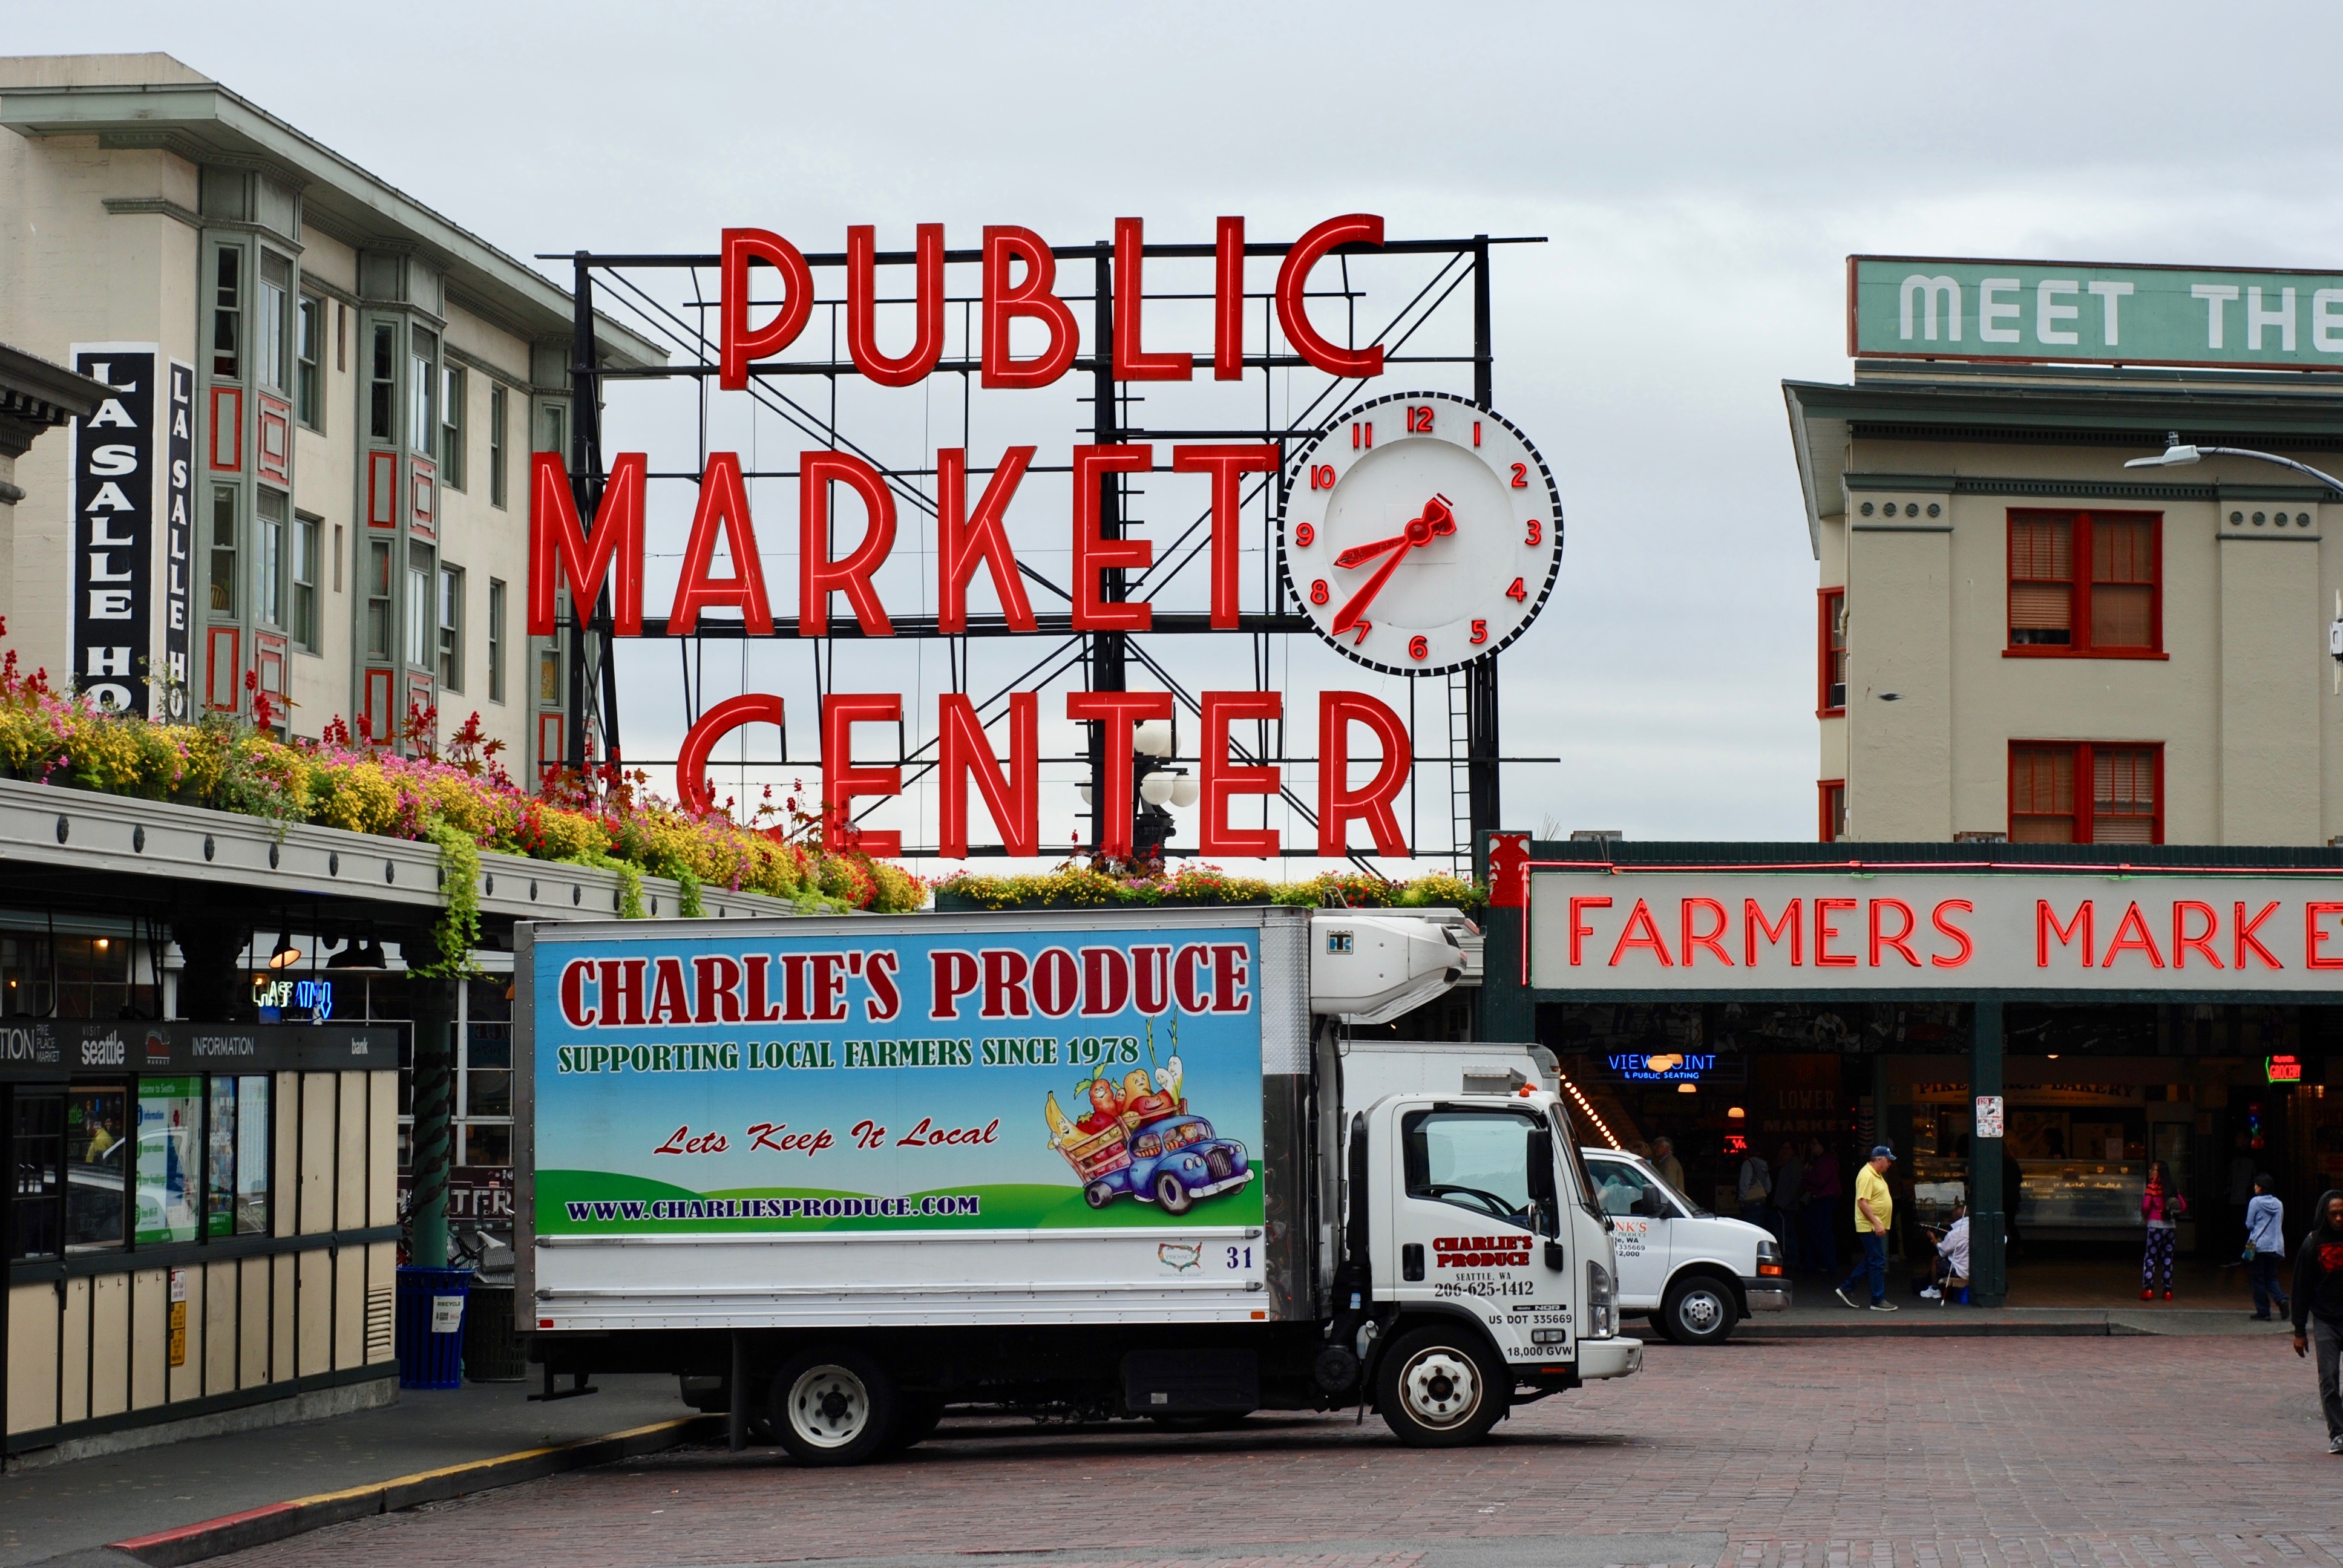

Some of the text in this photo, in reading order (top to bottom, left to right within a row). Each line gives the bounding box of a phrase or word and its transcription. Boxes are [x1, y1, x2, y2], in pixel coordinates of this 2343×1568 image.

[720, 214, 1384, 390] PUBLIC
[1900, 274, 2343, 352] MEET THE
[1406, 407, 1434, 433] 12
[1352, 422, 1372, 449] 11
[1473, 421, 1481, 448] 1
[1311, 464, 1336, 490] 10
[1510, 463, 1527, 488] 2
[84, 445, 138, 621] SALLE
[528, 443, 1280, 636] MARKET
[1296, 522, 1316, 547] 9
[1524, 519, 1542, 546] 3
[169, 461, 188, 630] SALLE
[1310, 579, 1330, 606] 8
[1506, 577, 1527, 603] 4
[1351, 621, 1372, 645] 7
[1469, 619, 1488, 645] 5
[1408, 635, 1428, 661] 6
[84, 646, 133, 714] HO
[168, 652, 186, 717] HO
[676, 690, 1412, 860] CENTER
[1568, 895, 1975, 970] FARMERS
[562, 944, 1250, 1027] CHARLIE'S PRODUCE
[36, 1024, 49, 1036] PIKE
[82, 1026, 100, 1036] VISIT
[36, 1037, 56, 1050] PLACE
[81, 1030, 125, 1065] seattle
[192, 1037, 254, 1056] INFORMATION
[351, 1037, 369, 1055] bank
[558, 1035, 1140, 1074] SUPPORTING LOCAL FARMERS SINCE 1978
[36, 1050, 60, 1063] MARKET
[1608, 1054, 1716, 1070] VIEWINT
[2269, 1065, 2301, 1079] GROCERY
[1779, 1091, 1835, 1110] LOWER
[654, 1117, 1000, 1157] Lets Keep It Local
[1763, 1120, 1850, 1132] MARKET
[566, 1196, 981, 1221] WWW.CHARLIESPRODUCE.COM
[1616, 1221, 1647, 1233] NK'S
[1432, 1236, 1533, 1252] CHARLIE'S
[1227, 1246, 1252, 1269] 31
[1437, 1252, 1530, 1268] PRODUCE
[1499, 1272, 1512, 1280] WA
[1434, 1281, 1534, 1298] 206-625-1412
[1489, 1315, 1572, 1324] US DOT 335669
[1507, 1347, 1573, 1357] 18,000 GVW
